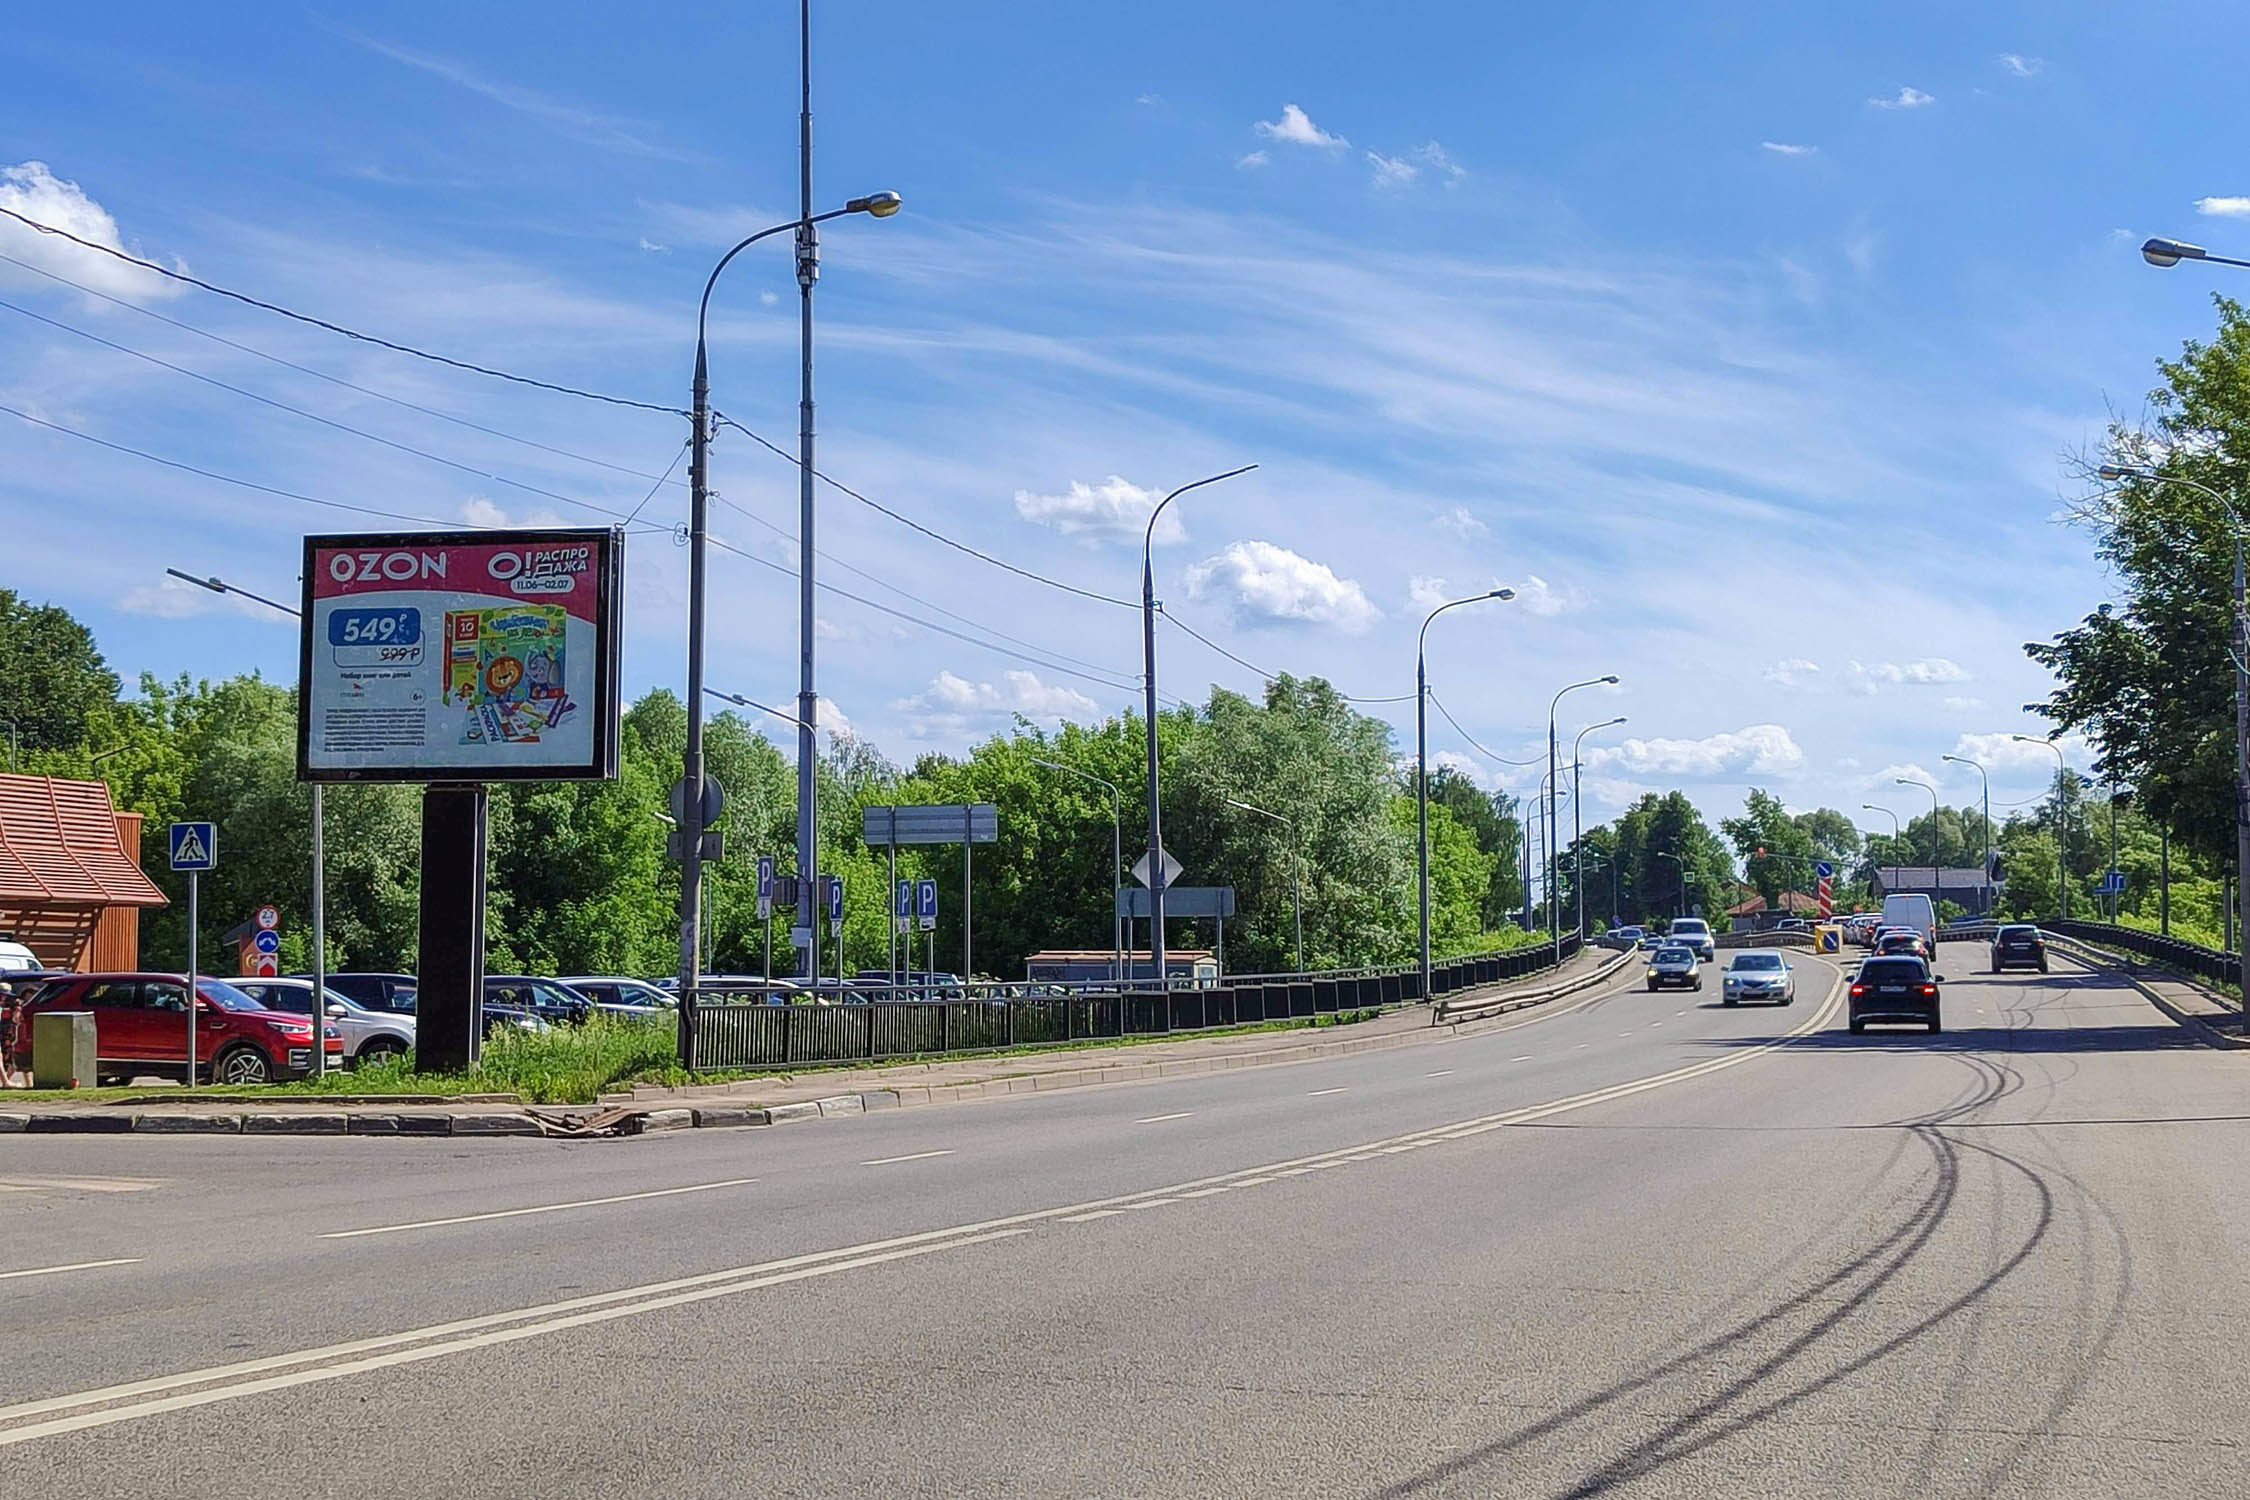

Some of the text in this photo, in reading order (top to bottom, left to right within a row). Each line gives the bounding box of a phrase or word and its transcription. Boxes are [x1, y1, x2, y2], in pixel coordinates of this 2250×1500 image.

[330, 552, 447, 582] OZON
[535, 548, 589, 562] РАСПРО
[533, 560, 587, 578] ДАЖА
[343, 617, 396, 642] 549
[461, 622, 475, 633] 10
[413, 693, 422, 701] 6+
[761, 861, 771, 894] P
[832, 885, 841, 915] P
[901, 885, 909, 914] P
[922, 884, 933, 914] P
